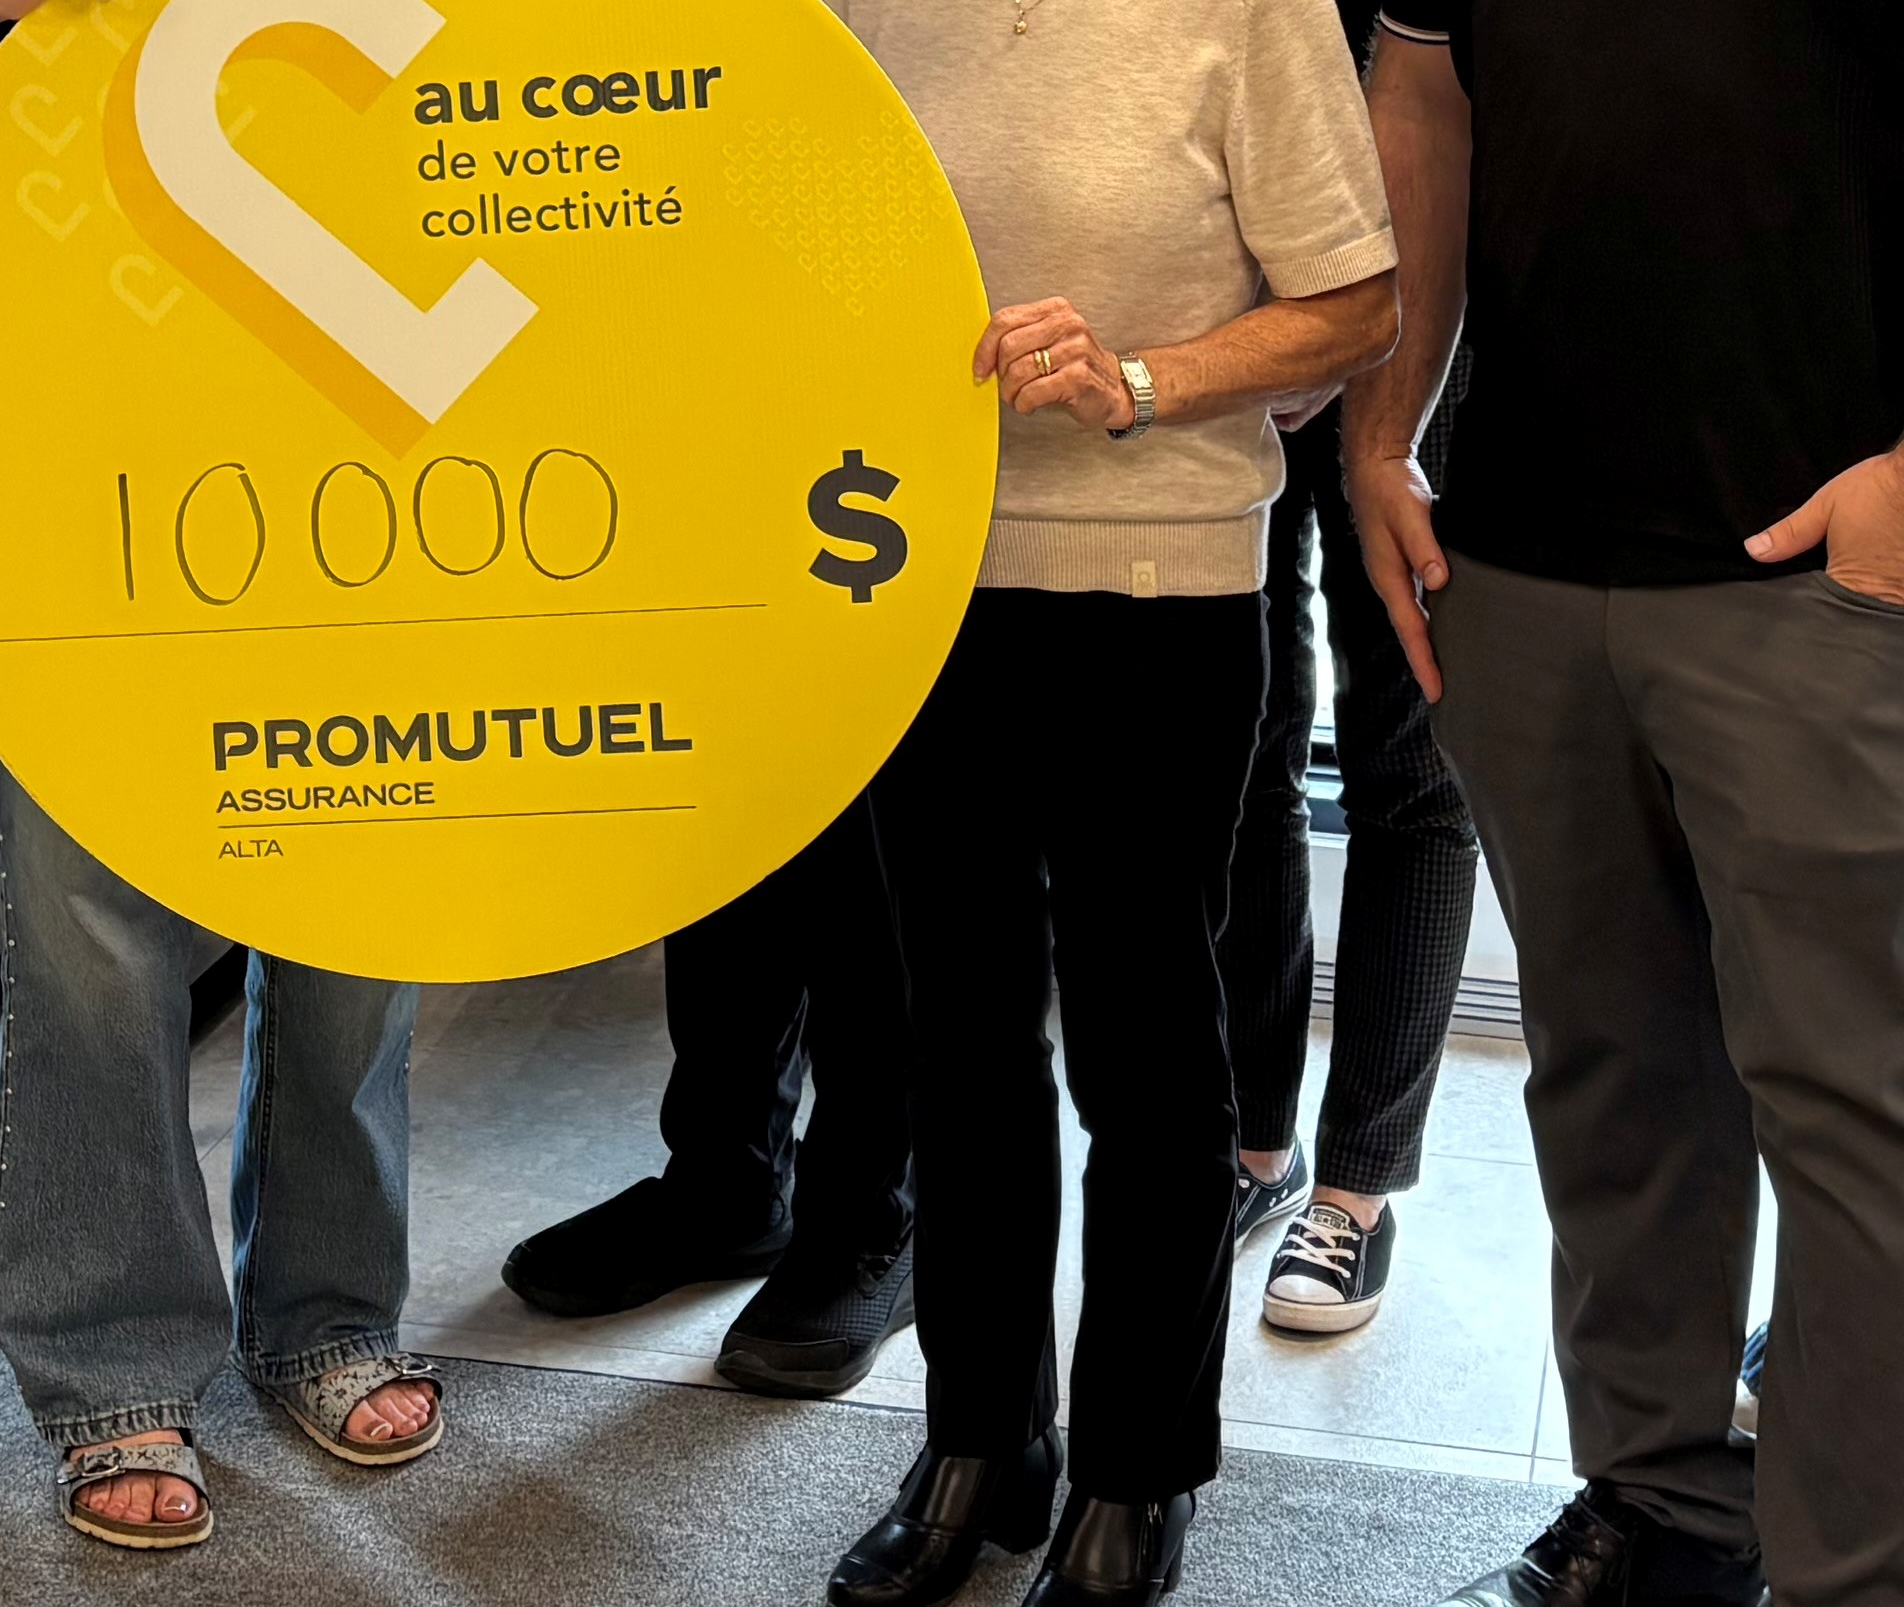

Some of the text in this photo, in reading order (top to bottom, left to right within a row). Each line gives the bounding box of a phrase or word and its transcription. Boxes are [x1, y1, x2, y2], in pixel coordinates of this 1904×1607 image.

[414, 66, 722, 125] au cœur
[418, 139, 622, 182] de votre
[422, 186, 683, 238] collectivité
[807, 448, 908, 604] $
[212, 702, 694, 771] PROMUTUEL
[216, 781, 436, 814] ASSURANCE
[218, 839, 285, 859] ALTA
